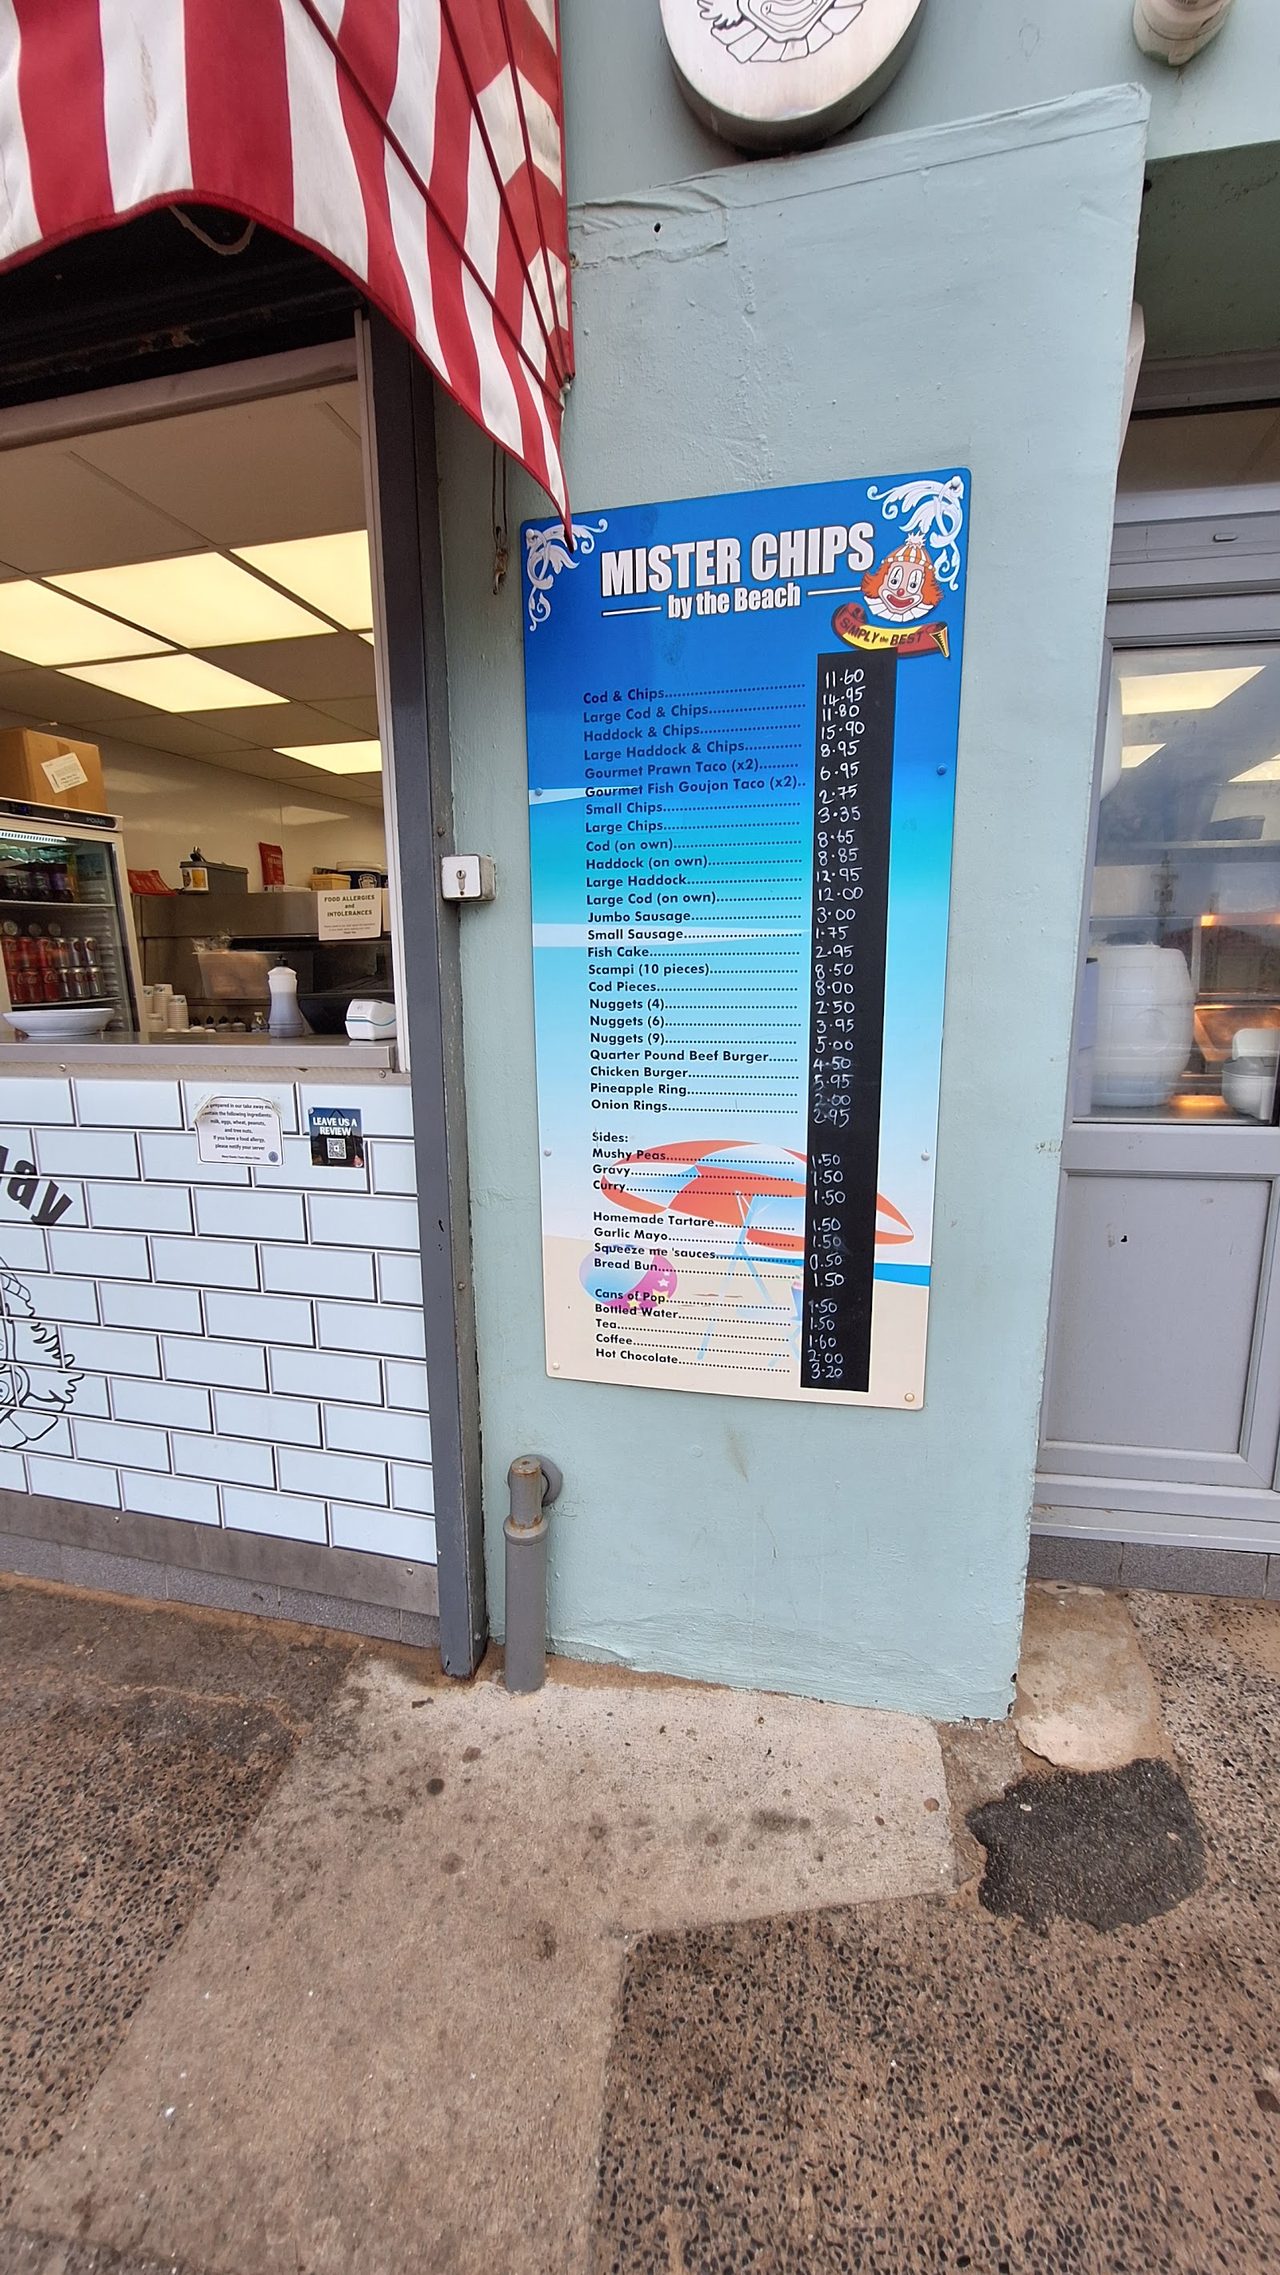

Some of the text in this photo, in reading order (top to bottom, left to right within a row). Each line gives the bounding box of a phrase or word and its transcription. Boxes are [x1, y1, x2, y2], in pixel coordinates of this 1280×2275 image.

[601, 521, 875, 598] MISTER CHIPS
[667, 582, 801, 620] by the Beach
[840, 617, 880, 644] SIMPLY
[889, 630, 924, 646] BEST
[825, 668, 865, 689] 11.60
[583, 687, 665, 704] Cod & Chips
[823, 685, 866, 707] 14.95
[583, 704, 709, 725] Large Cod & Chips
[822, 703, 860, 722] 11.80
[583, 724, 700, 742] Haddock & Chips
[821, 721, 865, 740] 15.90
[583, 740, 745, 762] Large Haddock & Chips
[820, 739, 860, 758] 8.95
[585, 757, 759, 779] Gourmet Prawn Taco (x2)
[820, 761, 860, 781] 6.95
[585, 775, 798, 798] Gourmet Fish Goujon Taco (x2)
[819, 783, 858, 804] 2.75
[585, 801, 663, 815] Small Chips
[817, 806, 861, 824] 3.35
[585, 819, 663, 834] Large Chips
[585, 837, 673, 853] Cod (on own)
[817, 829, 856, 848] 8.65
[586, 855, 708, 871] Haddock (on own)
[818, 847, 859, 866] 8.85
[586, 873, 687, 890] Large Haddock
[816, 867, 863, 883] 12.95
[342, 894, 375, 902] ALLERGIES
[586, 891, 716, 908] Large Cod (on own)
[818, 886, 864, 902] 12.00
[327, 909, 372, 917] INTOLERANCES
[587, 910, 691, 924] Jumbo Sausage
[816, 906, 856, 924] 3.00
[587, 928, 683, 942] Small Sausage
[815, 925, 849, 940] 1.75
[587, 946, 650, 958] Fish Cake
[815, 944, 855, 959] 2.95
[588, 963, 710, 977] Scampi (10 pieces)
[814, 963, 854, 980] 8.50
[588, 981, 657, 993] Cod Pieces
[815, 980, 854, 997] 8.00
[589, 998, 665, 1012] Nuggets (4)
[815, 1000, 855, 1014] 2.50
[590, 1015, 665, 1029] Nuggets (6)
[816, 1018, 855, 1034] 3.95
[590, 1032, 665, 1046] Nuggets (9)
[814, 1036, 854, 1054] 5.00
[590, 1049, 769, 1064] Quarter Pound Beef Burger
[813, 1056, 852, 1072] 4.50
[590, 1066, 688, 1080] Chicken Burger
[590, 1083, 688, 1097] Pineapple Ring
[591, 1099, 668, 1113] Onion Rings
[312, 1116, 357, 1127] LEAVE US A
[813, 1107, 851, 1128] 2.95
[320, 1126, 352, 1136] REVIEW
[592, 1132, 629, 1143] Sides:
[592, 1148, 666, 1161] Mushy Peas
[811, 1153, 841, 1169] 1.50
[592, 1164, 630, 1177] Gravy
[813, 1170, 844, 1187] 1.50
[592, 1180, 626, 1193] Curry
[814, 1189, 846, 1206] 1.50
[593, 1212, 715, 1227] Homemade Tartare
[812, 1217, 841, 1232] 1.50
[594, 1227, 668, 1242] Garlic Mayo
[812, 1233, 842, 1249] 1.50
[594, 1243, 645, 1255] Squeeze
[649, 1248, 668, 1257] me
[594, 1258, 658, 1272] Bread Bun
[809, 1251, 843, 1271] 0.50
[814, 1272, 845, 1287] 1.50
[595, 1288, 666, 1304] Cans of Pop
[595, 1304, 678, 1319] Bottled Water
[808, 1297, 838, 1314] 1.50
[595, 1319, 617, 1329] Tea
[810, 1314, 835, 1331] 1.50
[596, 1333, 633, 1346] Coffee
[809, 1334, 837, 1350] 1.60
[595, 1348, 678, 1364] Hot Chocolate
[807, 1349, 844, 1364] 2.00
[811, 1362, 843, 1380] 3.20
